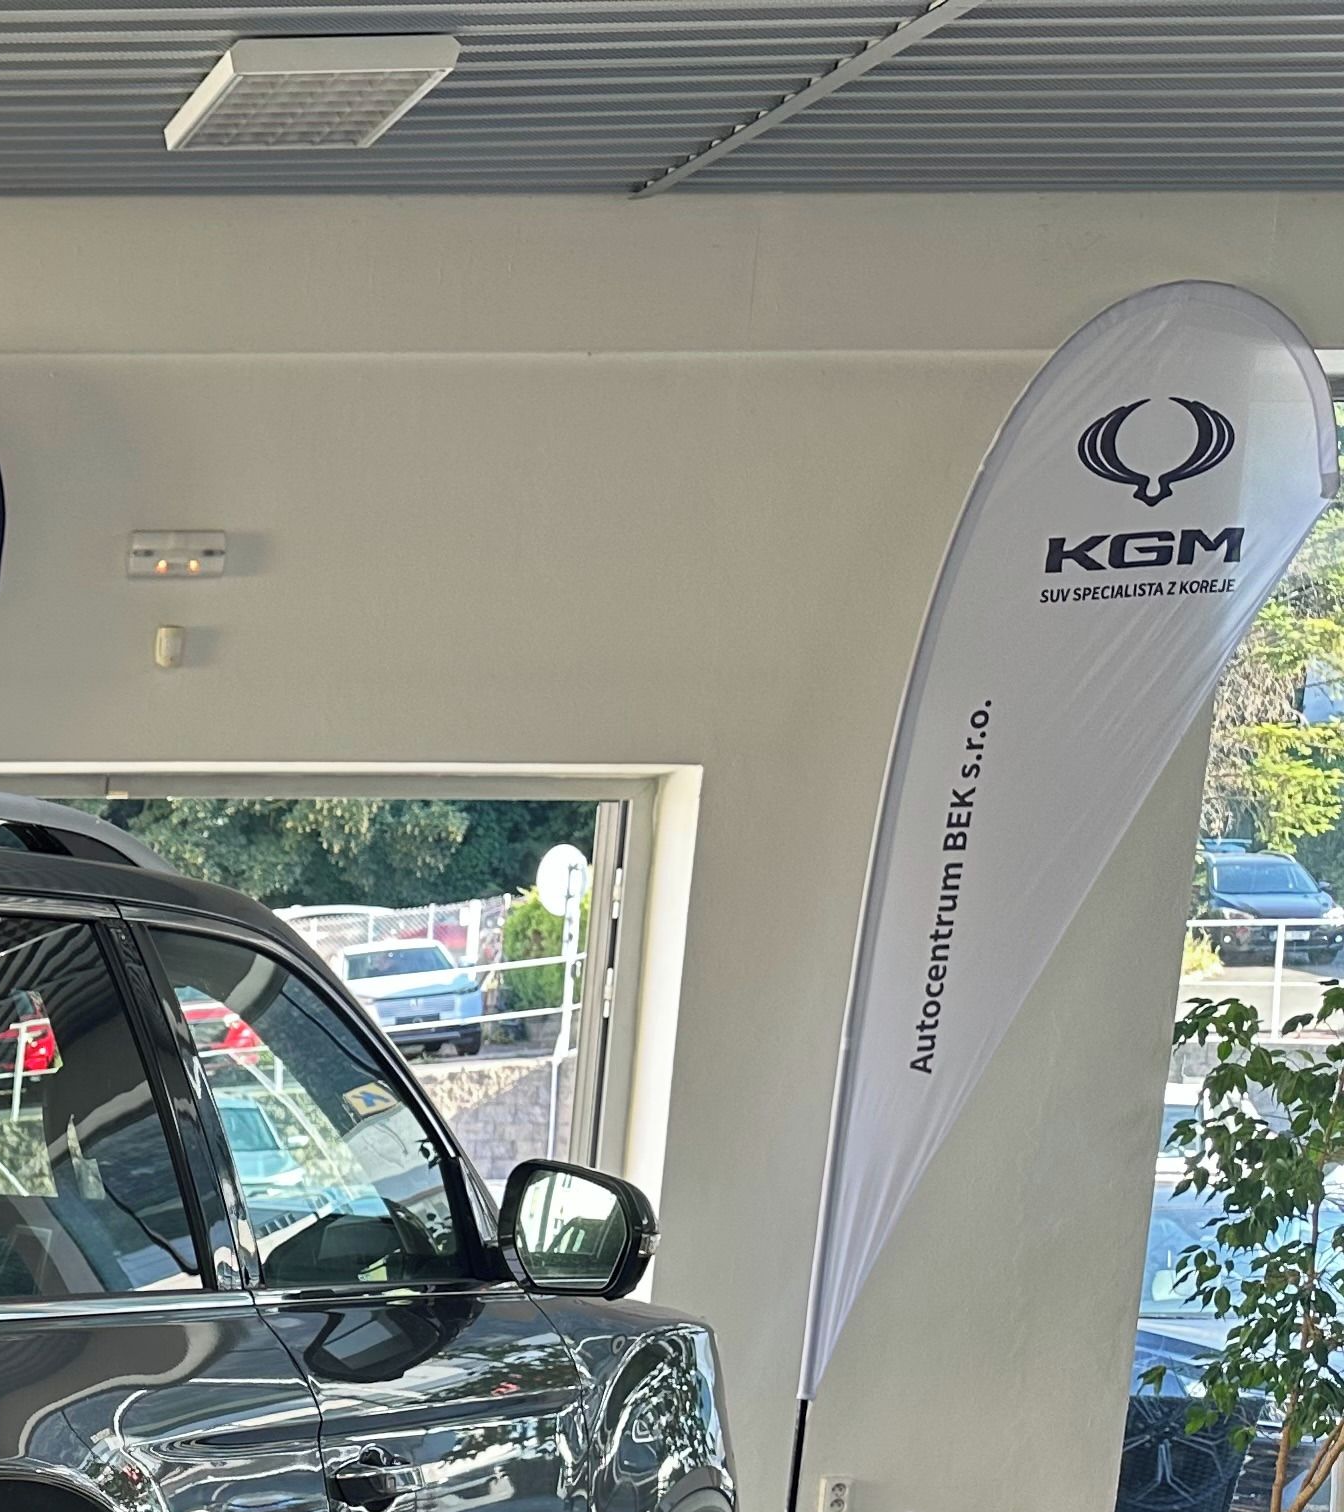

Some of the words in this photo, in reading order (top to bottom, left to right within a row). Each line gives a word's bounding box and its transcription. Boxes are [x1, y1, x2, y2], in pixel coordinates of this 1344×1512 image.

[1045, 527, 1245, 573] KGM
[1039, 588, 1071, 603] SUV
[1072, 582, 1164, 602] SPECIALISTA
[1166, 581, 1178, 596] Z
[1179, 578, 1236, 595] KOREJE
[909, 861, 963, 1076] Autocentrum
[942, 786, 977, 852] BEK
[961, 699, 993, 779] s.r.o.
